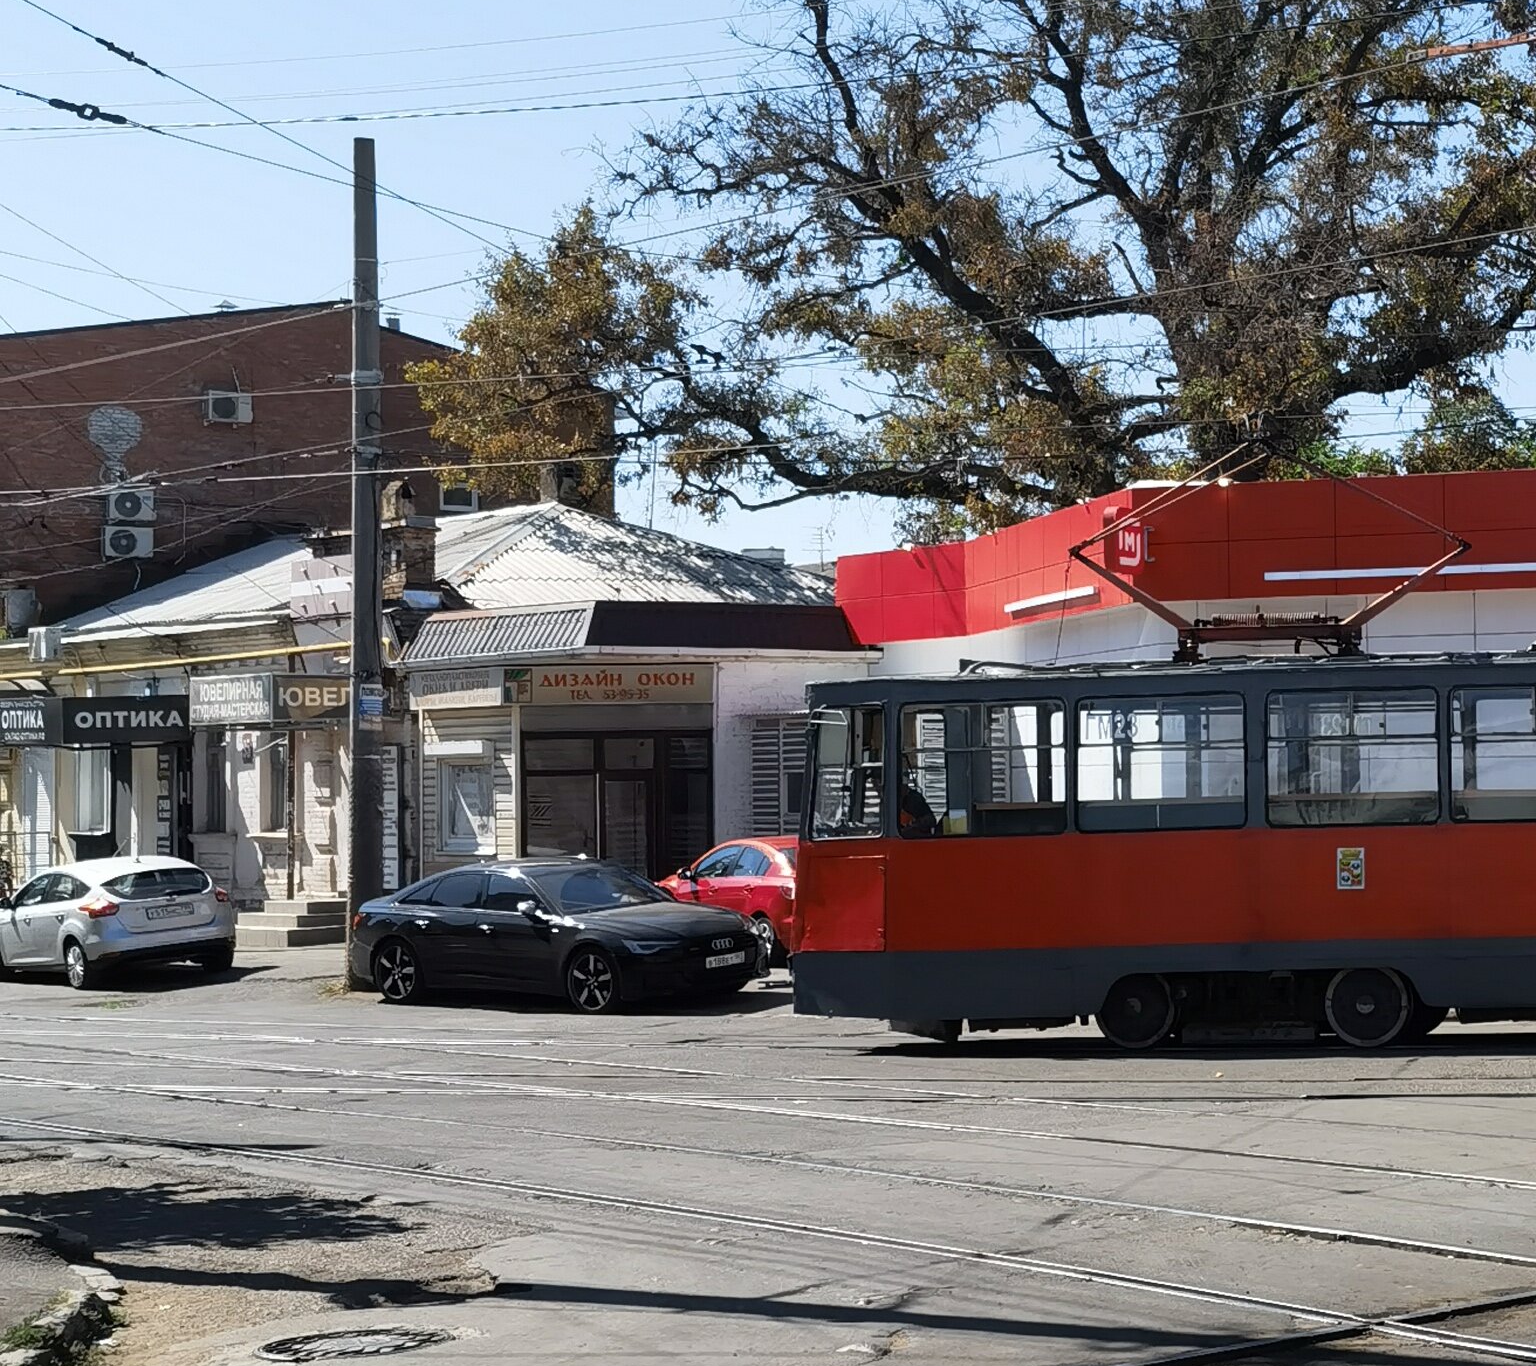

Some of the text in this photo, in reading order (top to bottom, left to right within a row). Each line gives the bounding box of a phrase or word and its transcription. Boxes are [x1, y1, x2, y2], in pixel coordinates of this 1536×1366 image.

[539, 669, 696, 688] ДИЗАЙН ОКОН
[199, 680, 263, 702] ЮВЕЛИРНАЯ
[1, 710, 45, 729] ОПТИКА
[74, 710, 184, 729] ОПТИКА
